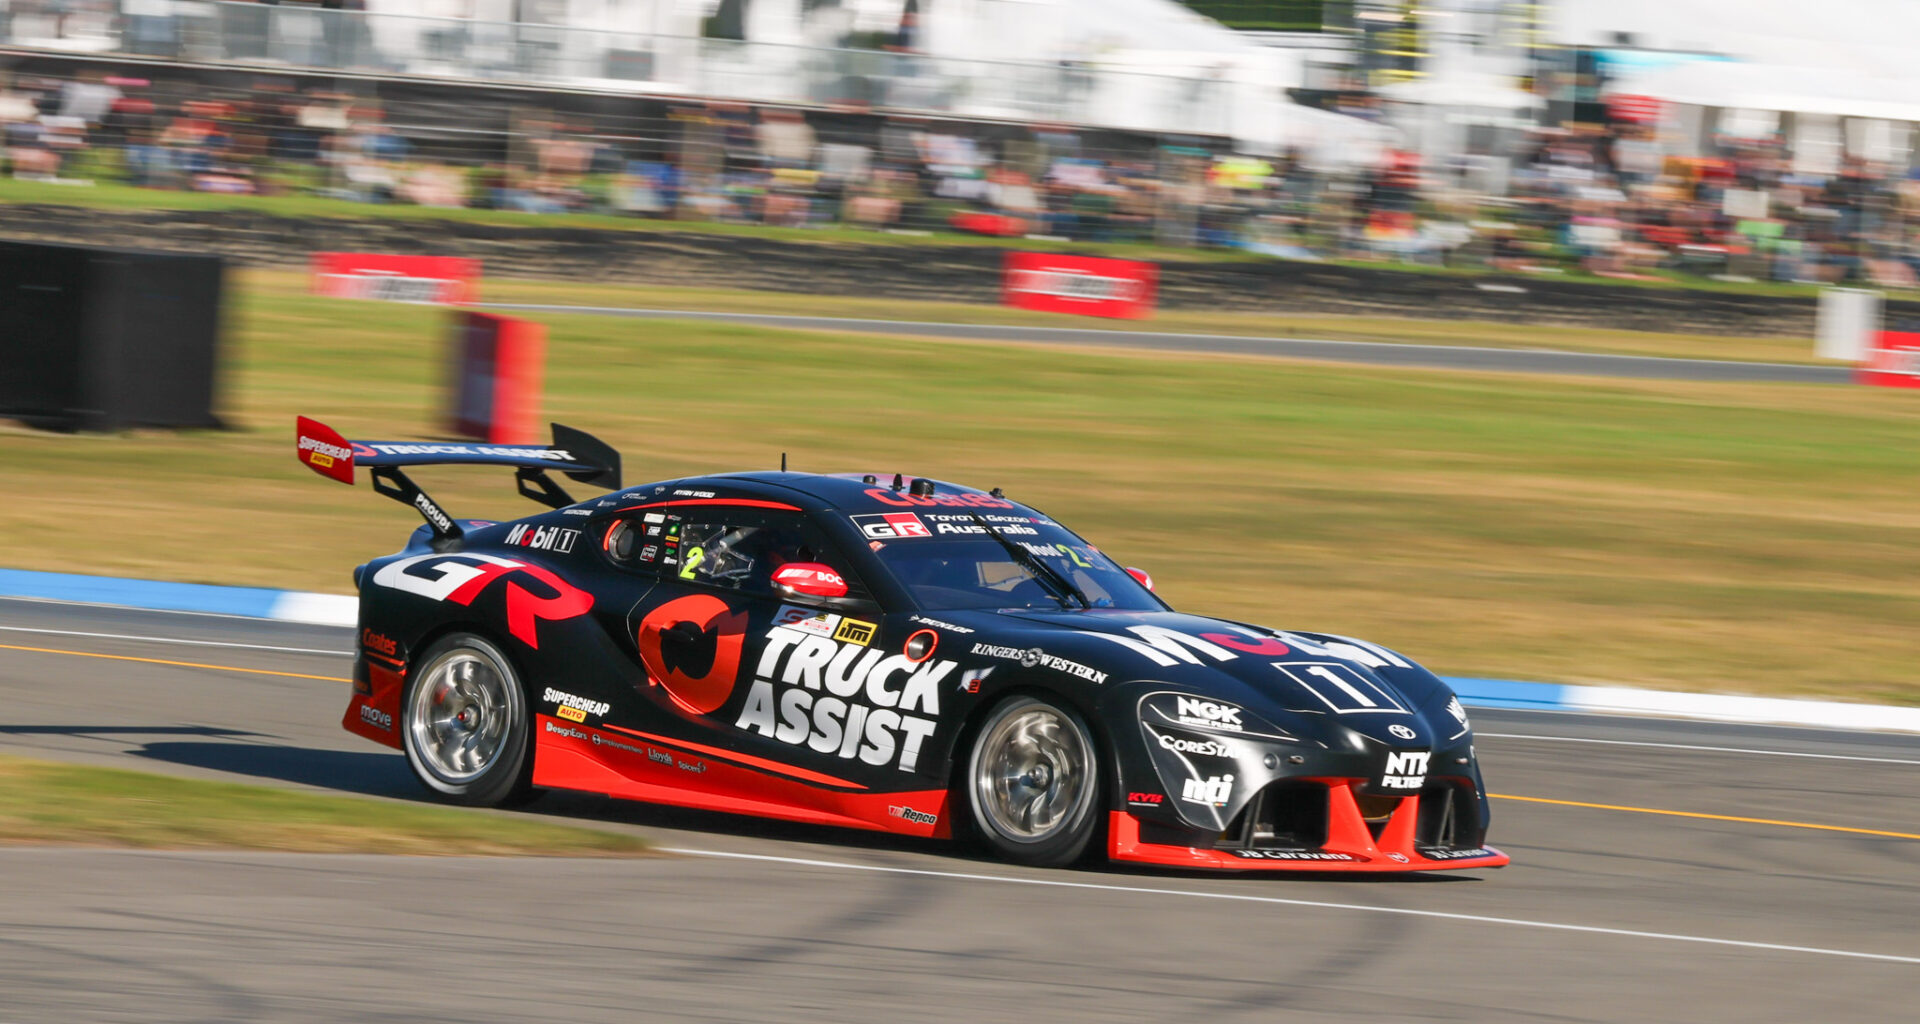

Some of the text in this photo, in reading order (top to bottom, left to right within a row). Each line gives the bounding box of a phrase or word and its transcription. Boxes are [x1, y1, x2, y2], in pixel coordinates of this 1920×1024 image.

[298, 436, 351, 462] SUPERCHEAP
[370, 444, 577, 461] TRUCK ASSIST
[505, 523, 557, 551] Mobil
[863, 521, 929, 537] GR
[680, 547, 704, 580] 2
[1056, 543, 1092, 568] 2
[817, 571, 844, 585] BOC
[373, 552, 595, 650] GR
[918, 617, 976, 634] DUNLOP
[363, 628, 397, 656] Coates
[756, 626, 958, 715] TRUCK
[970, 642, 1110, 685] RINGERS WESTERN
[543, 687, 611, 717] SUPERCHEAP
[560, 708, 583, 720] AUTO
[1177, 696, 1243, 724] NGK
[361, 704, 392, 727] move
[735, 679, 937, 773] ASSIST
[1127, 792, 1164, 803] KYB
[1182, 774, 1235, 803] nti
[902, 806, 938, 825] Repco
[1264, 850, 1353, 861] Caravans
